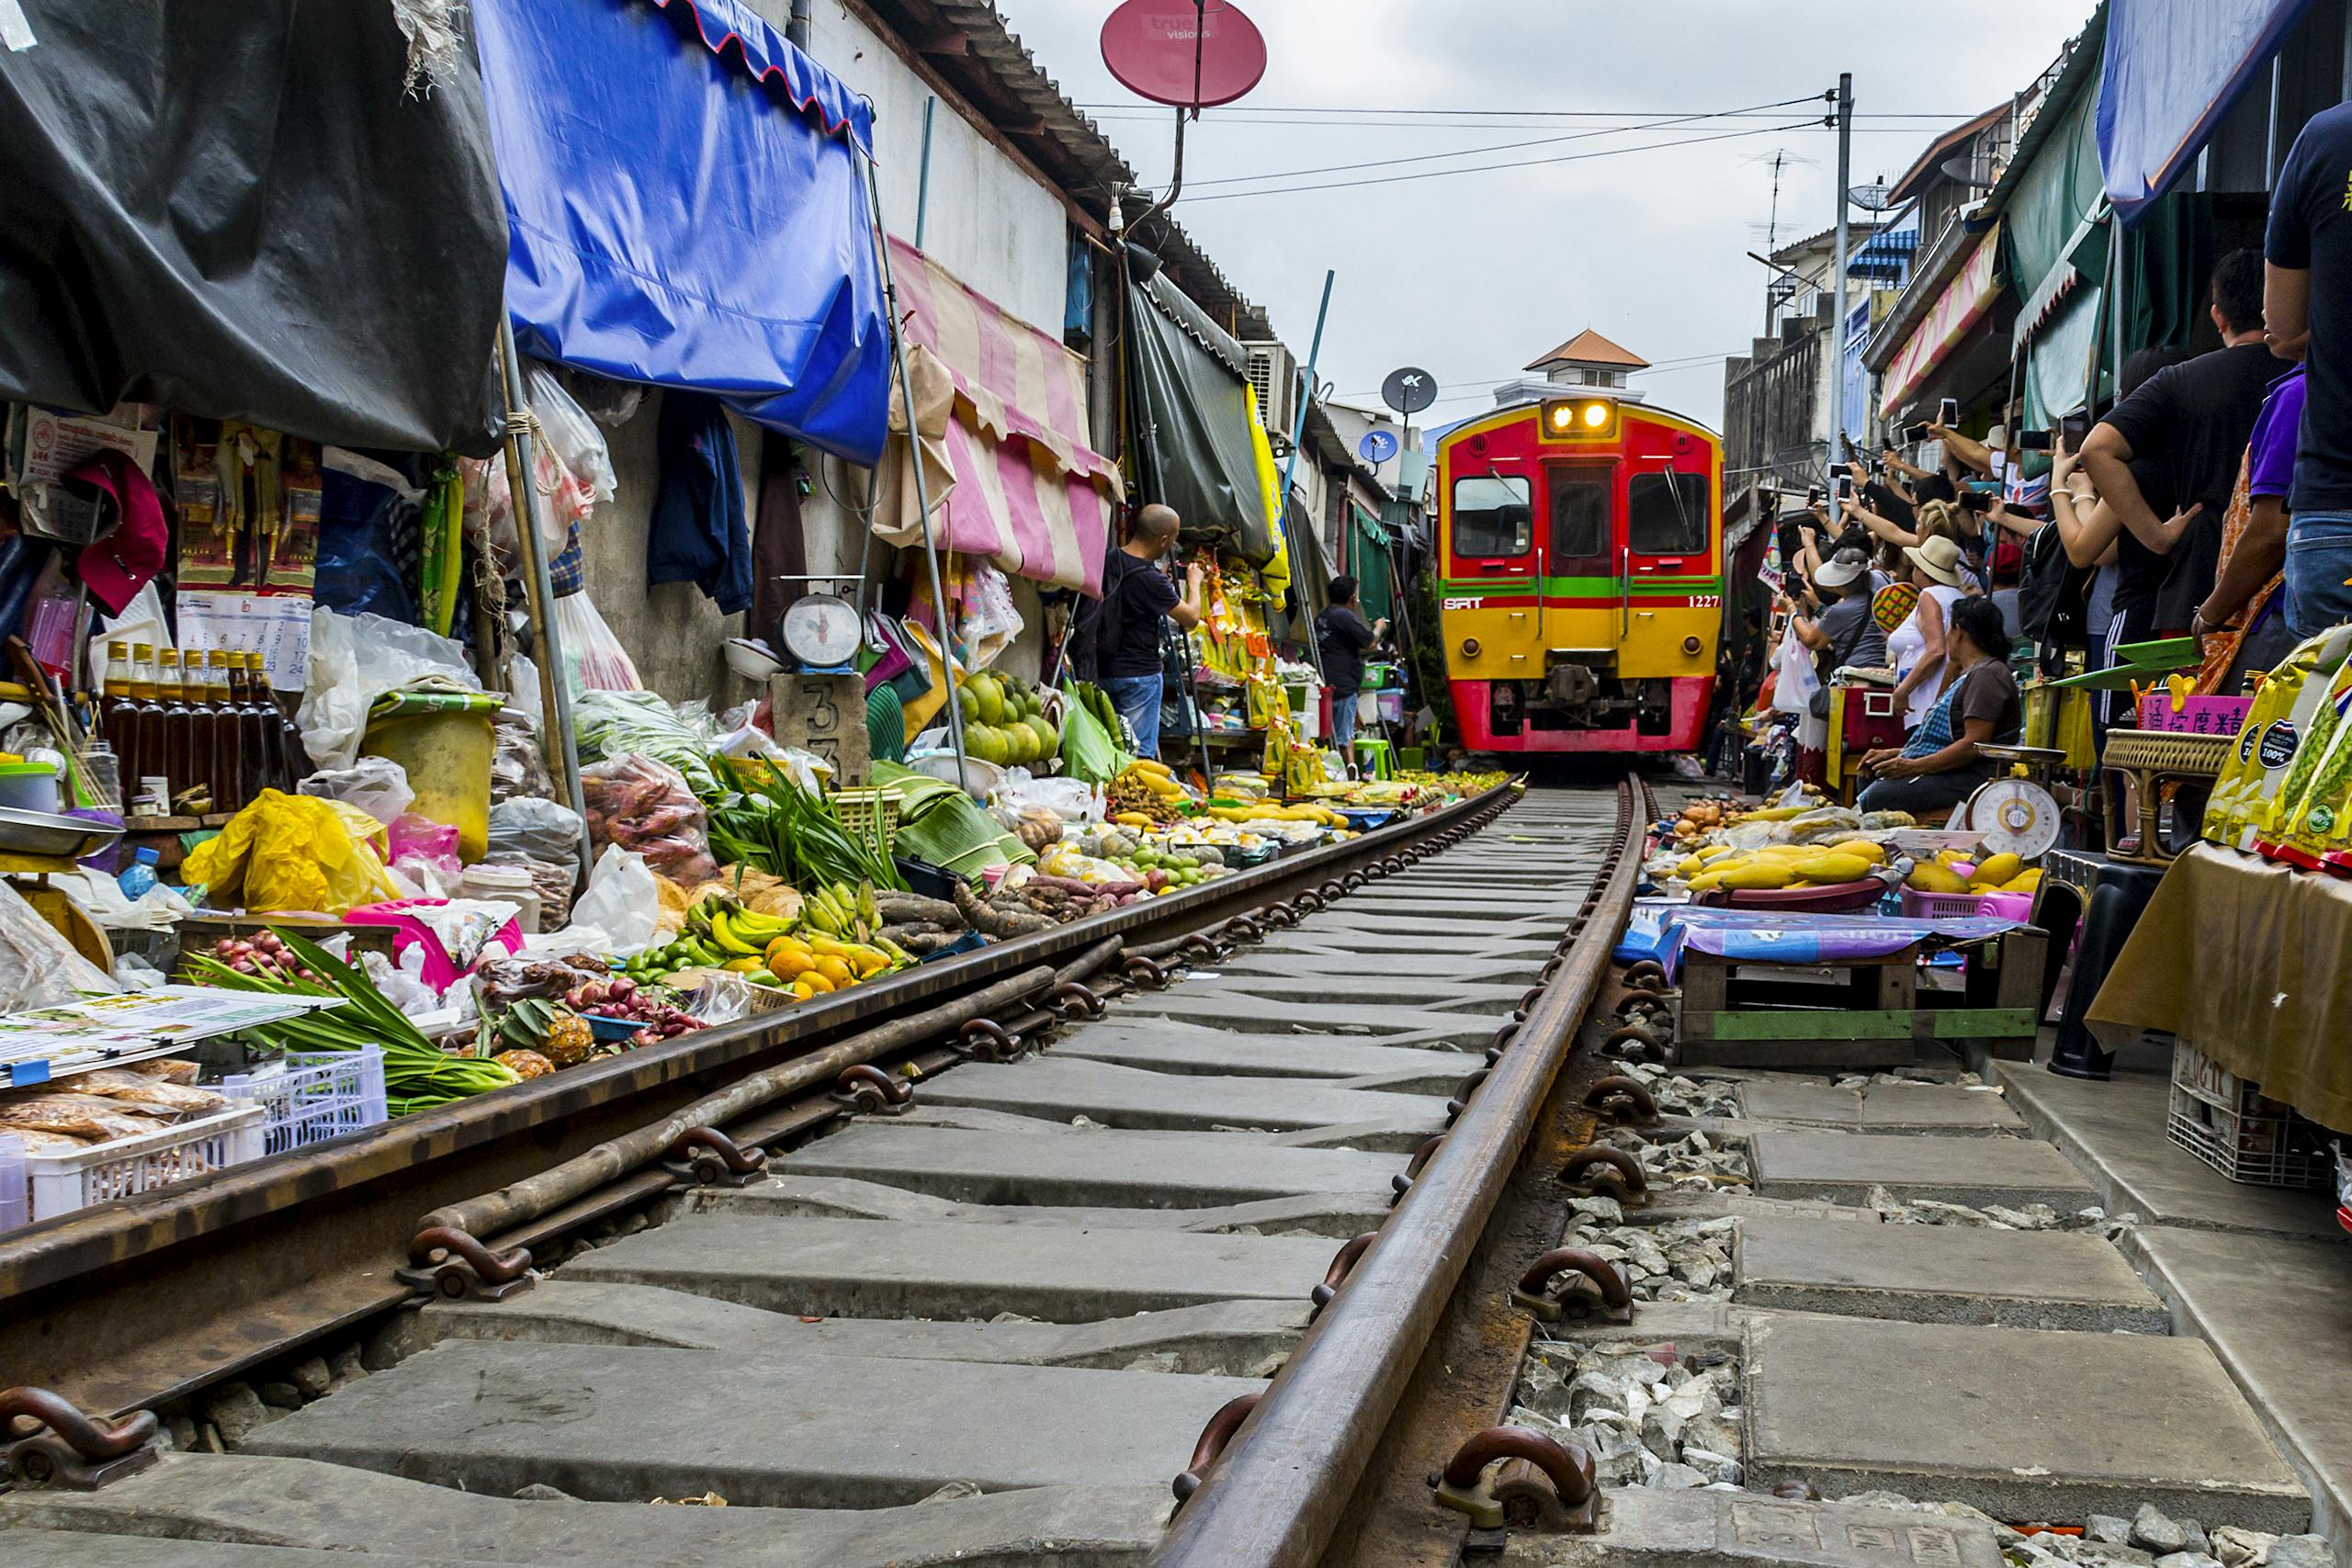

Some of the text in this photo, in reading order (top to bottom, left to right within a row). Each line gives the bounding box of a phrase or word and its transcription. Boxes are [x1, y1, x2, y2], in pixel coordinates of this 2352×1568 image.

[1151, 17, 1193, 29] true
[1443, 597, 1484, 610] SRT
[1689, 595, 1719, 608] 1227
[296, 637, 308, 649] 10
[294, 650, 306, 661] 17
[288, 664, 304, 674] 24
[2261, 748, 2286, 762] 100%
